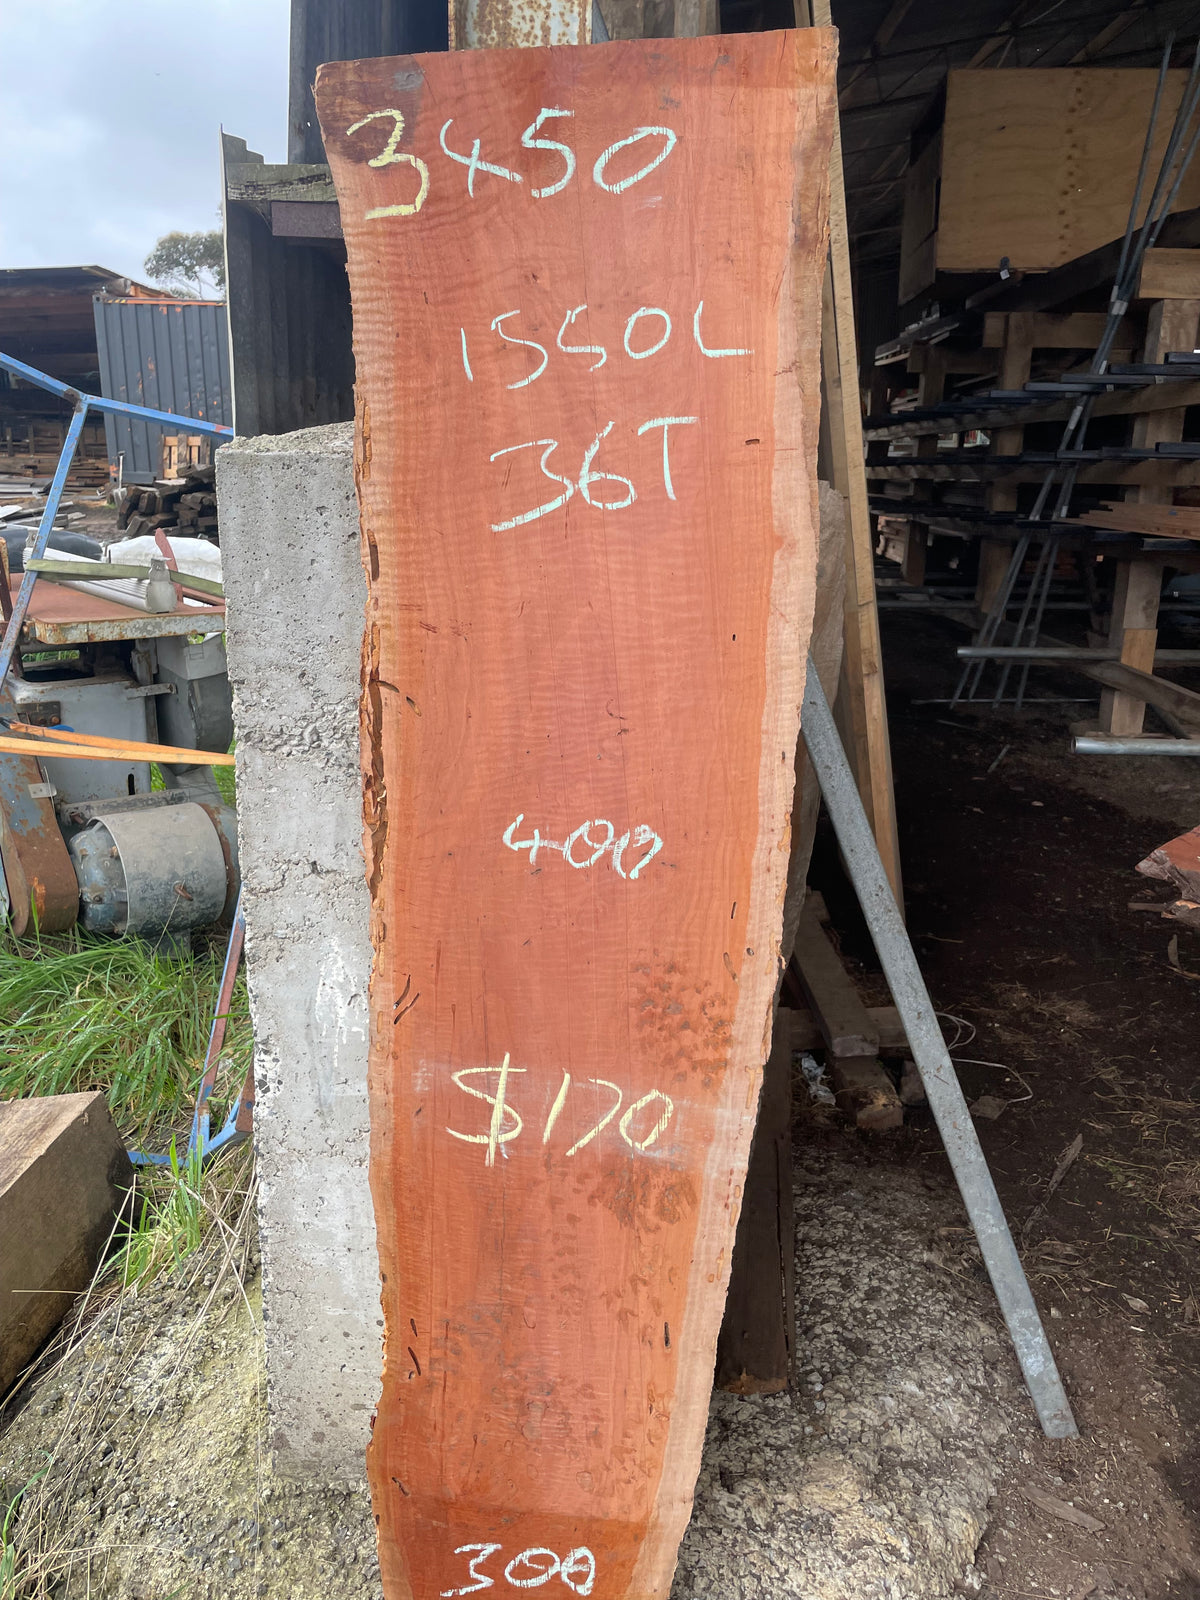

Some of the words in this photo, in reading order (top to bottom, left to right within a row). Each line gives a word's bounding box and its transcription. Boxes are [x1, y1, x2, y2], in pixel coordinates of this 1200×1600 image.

[490, 415, 698, 532] 36T
[445, 1051, 674, 1168] $170
[439, 1542, 596, 1598] 300
